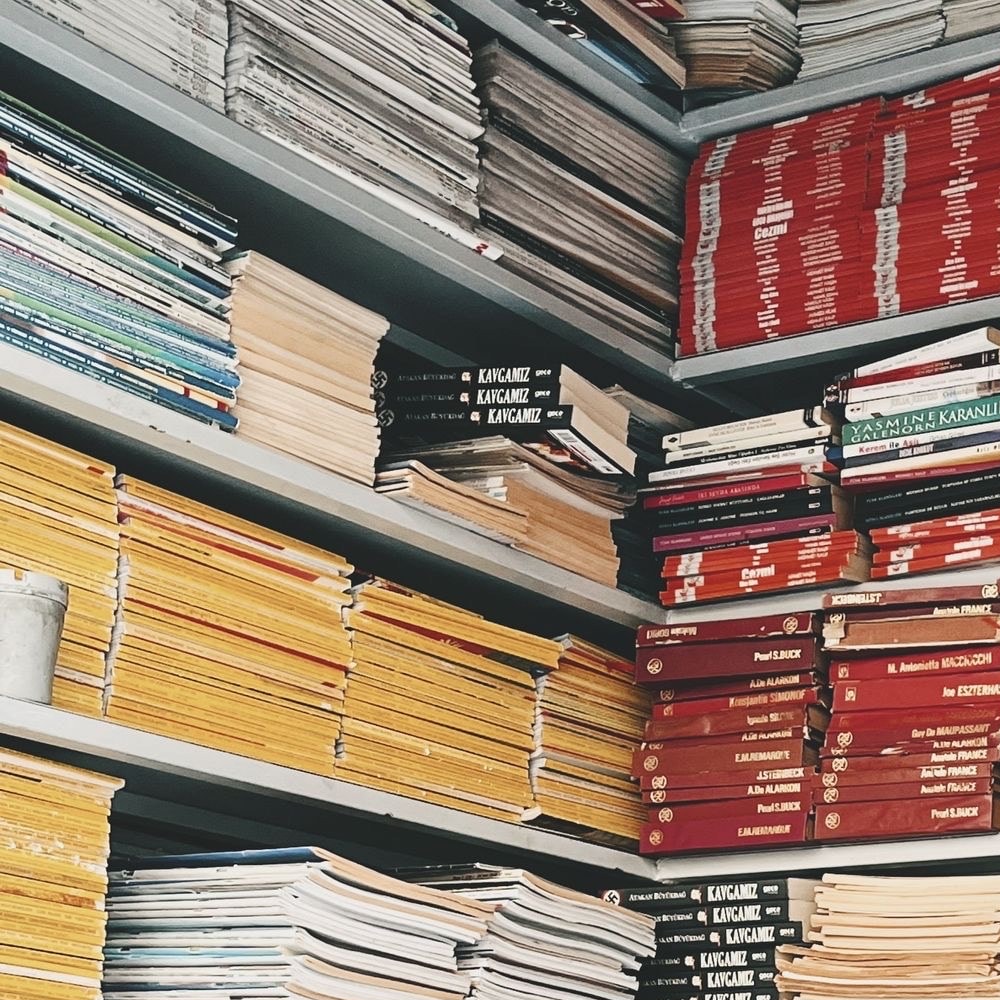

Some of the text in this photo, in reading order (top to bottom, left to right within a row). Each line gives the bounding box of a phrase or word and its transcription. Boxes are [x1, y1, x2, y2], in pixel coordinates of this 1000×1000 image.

[478, 367, 530, 384] KAVGAMIZ
[477, 388, 529, 404] KAVGAMIZ
[488, 408, 542, 424] KAVGAMIZ
[852, 412, 935, 434] YASMINE
[851, 422, 936, 443] GALENORN
[962, 604, 992, 614] FRANCE
[754, 649, 802, 662] Pearl S.BUCK
[936, 724, 991, 736] MAUPASSANT
[765, 782, 800, 793] ALARKON
[774, 800, 801, 812] S.BUCK
[708, 884, 758, 902] KAVGAMIZ
[713, 905, 762, 924] KAVGAMIZ
[726, 926, 775, 944] KAVGAMIZ
[700, 950, 748, 968] KAVGAMIZ
[708, 970, 754, 988] KAVGAMIZ
